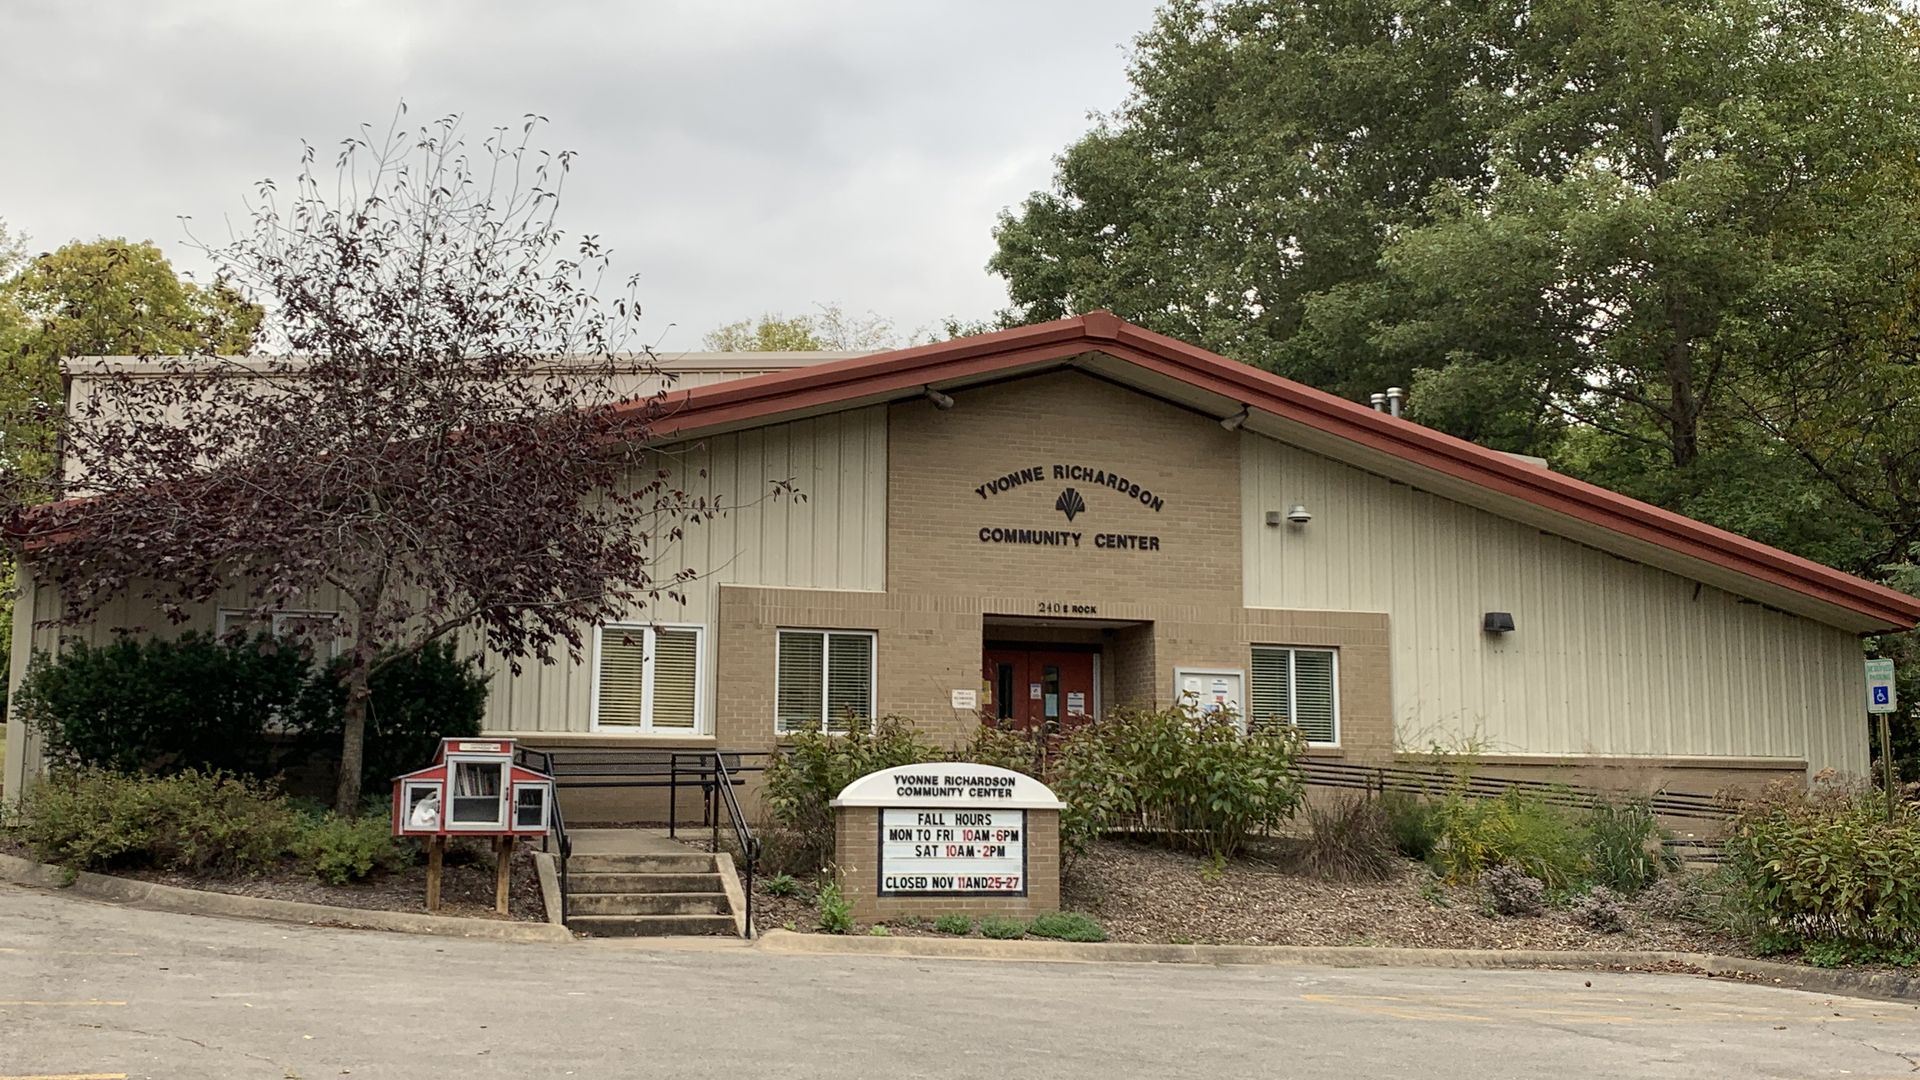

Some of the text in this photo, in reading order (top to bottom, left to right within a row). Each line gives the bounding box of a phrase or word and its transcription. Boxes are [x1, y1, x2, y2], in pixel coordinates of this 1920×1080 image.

[975, 464, 1164, 512] YVONNE RICHARDSON
[979, 527, 1160, 551] COMMUNITY CENTER
[1038, 602, 1060, 613] 240
[1072, 605, 1097, 614] ROCK
[894, 775, 1016, 787] YVONNE RICHARDSON
[897, 787, 1012, 798] COMMUNITY CENTER
[918, 813, 992, 826] FALL HOURS
[889, 829, 912, 841] MON
[917, 829, 931, 841] TO
[936, 829, 954, 841] FRI
[915, 845, 939, 857] SAT
[886, 877, 928, 889] CLOSED
[932, 877, 954, 889] NOV
